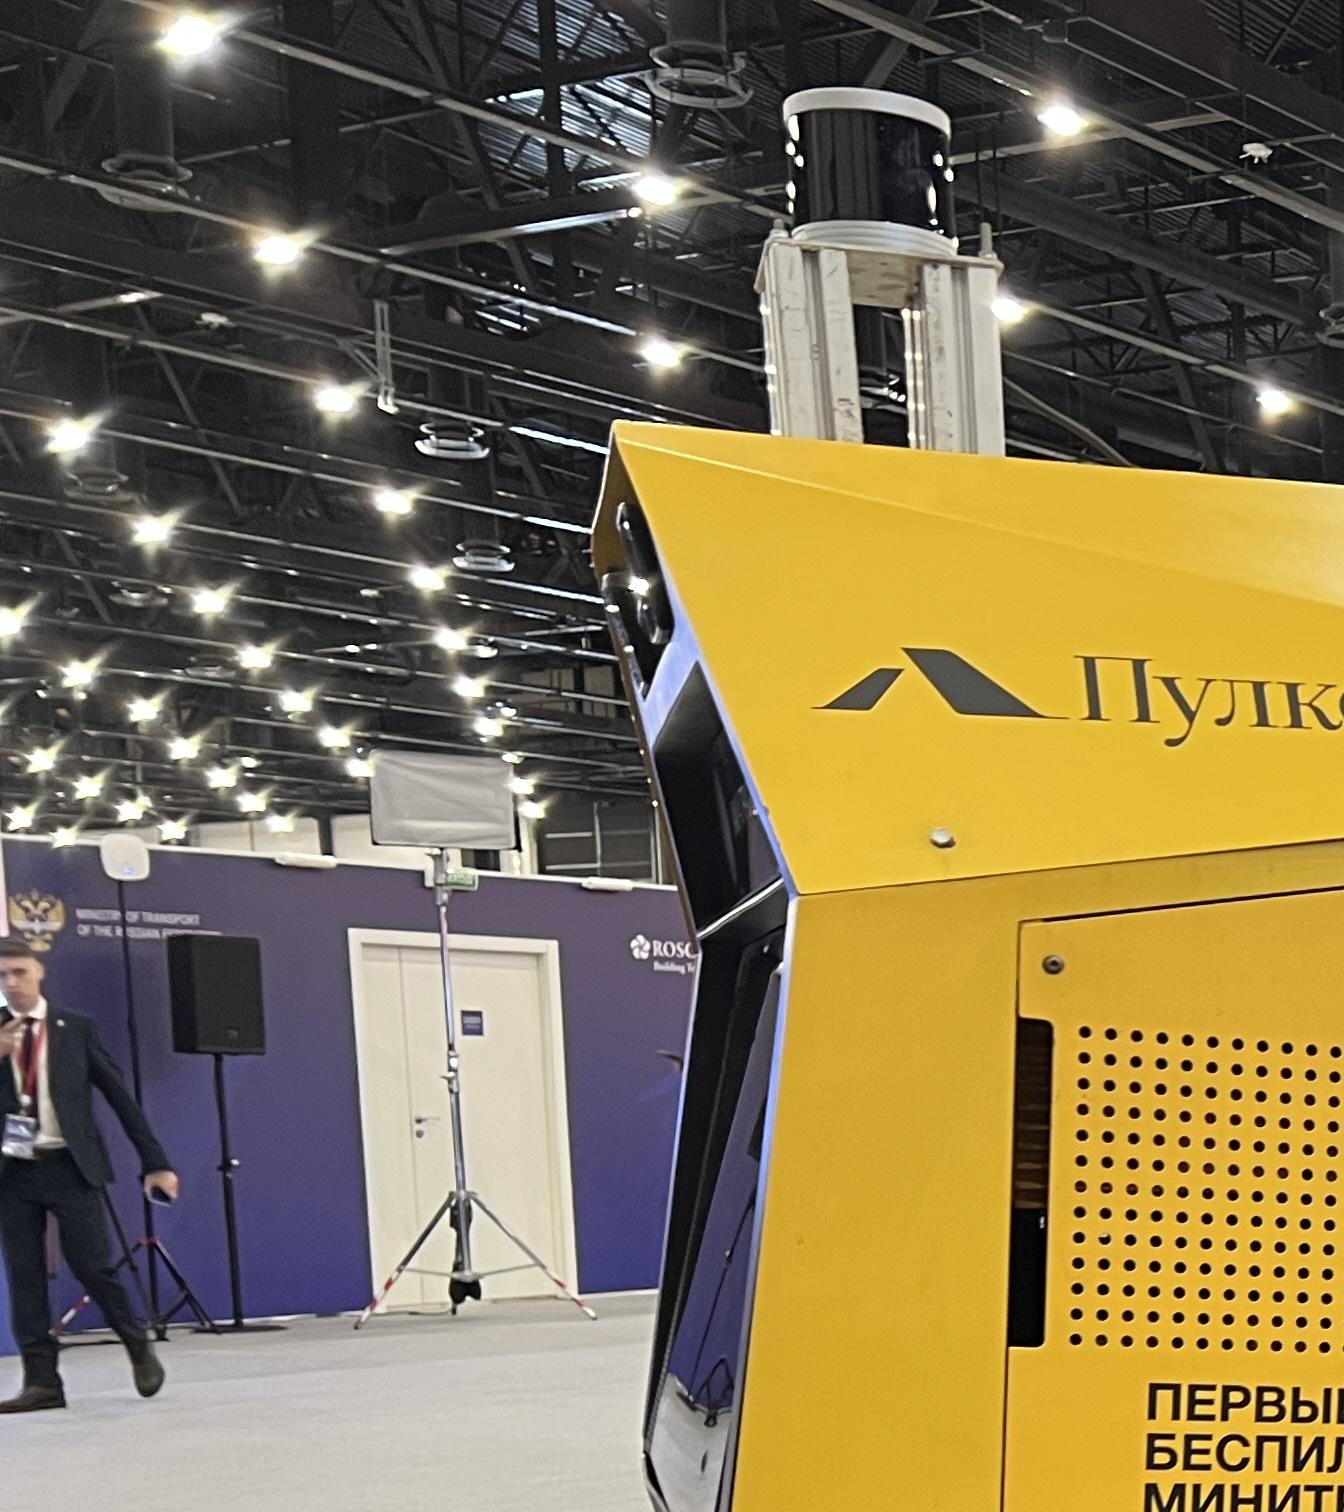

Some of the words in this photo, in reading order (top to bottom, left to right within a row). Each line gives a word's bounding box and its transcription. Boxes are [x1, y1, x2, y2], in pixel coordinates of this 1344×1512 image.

[125, 911, 139, 923] OF
[142, 911, 200, 925] TRANSPORT
[114, 925, 160, 938] RSSIAN
